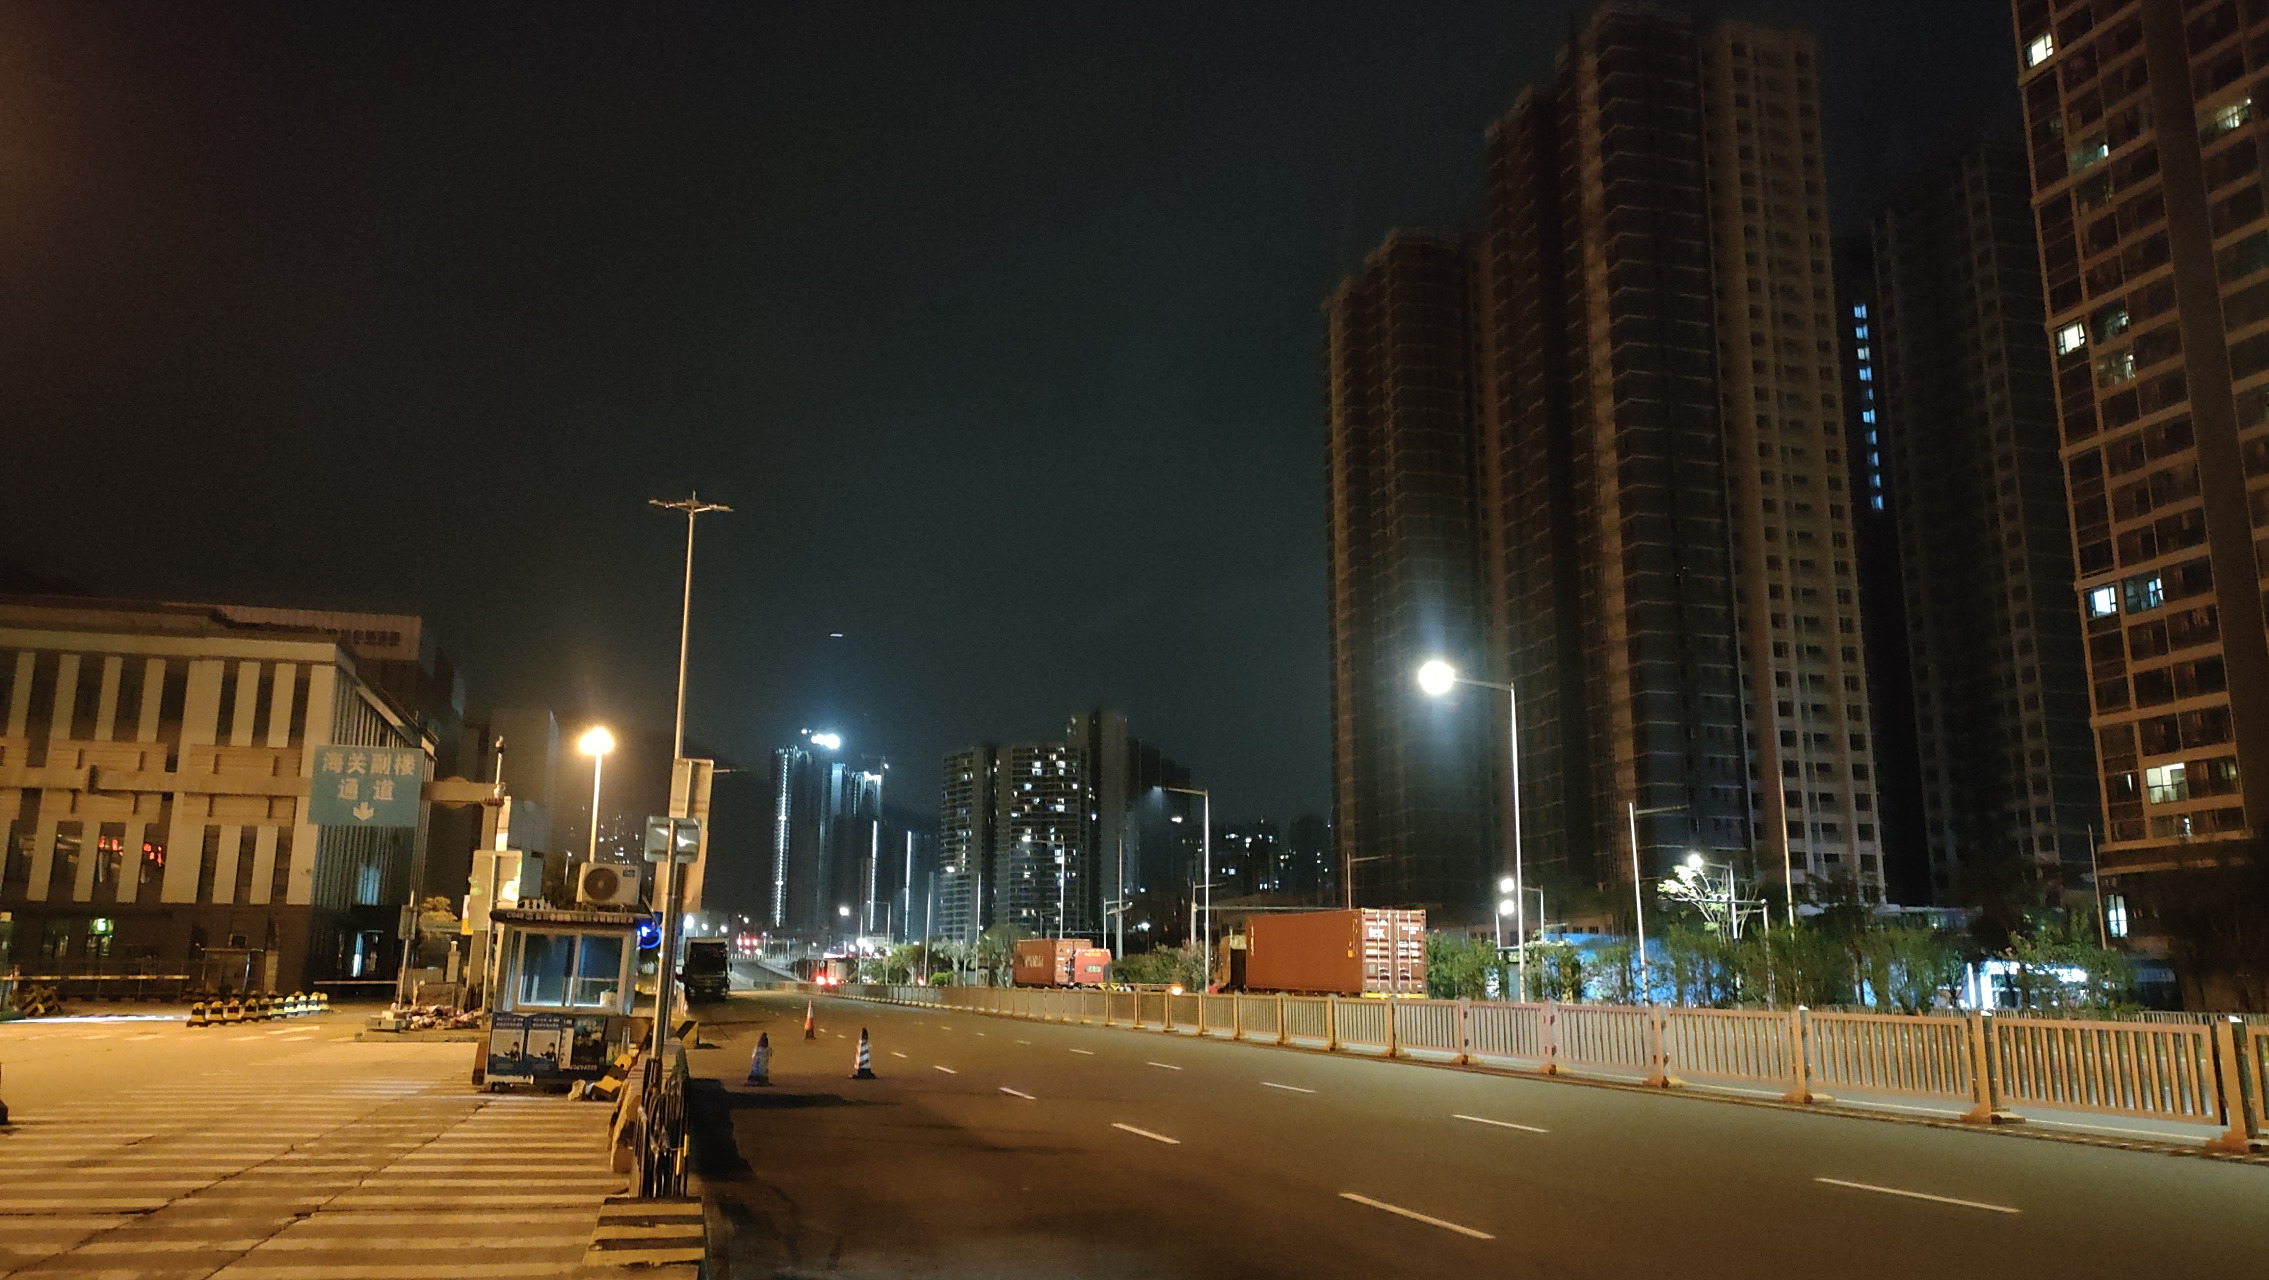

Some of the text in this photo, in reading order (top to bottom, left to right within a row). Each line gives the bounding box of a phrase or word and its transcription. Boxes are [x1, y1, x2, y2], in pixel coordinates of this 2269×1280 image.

[322, 752, 416, 776] 海关副楼
[338, 778, 395, 801] 通道
